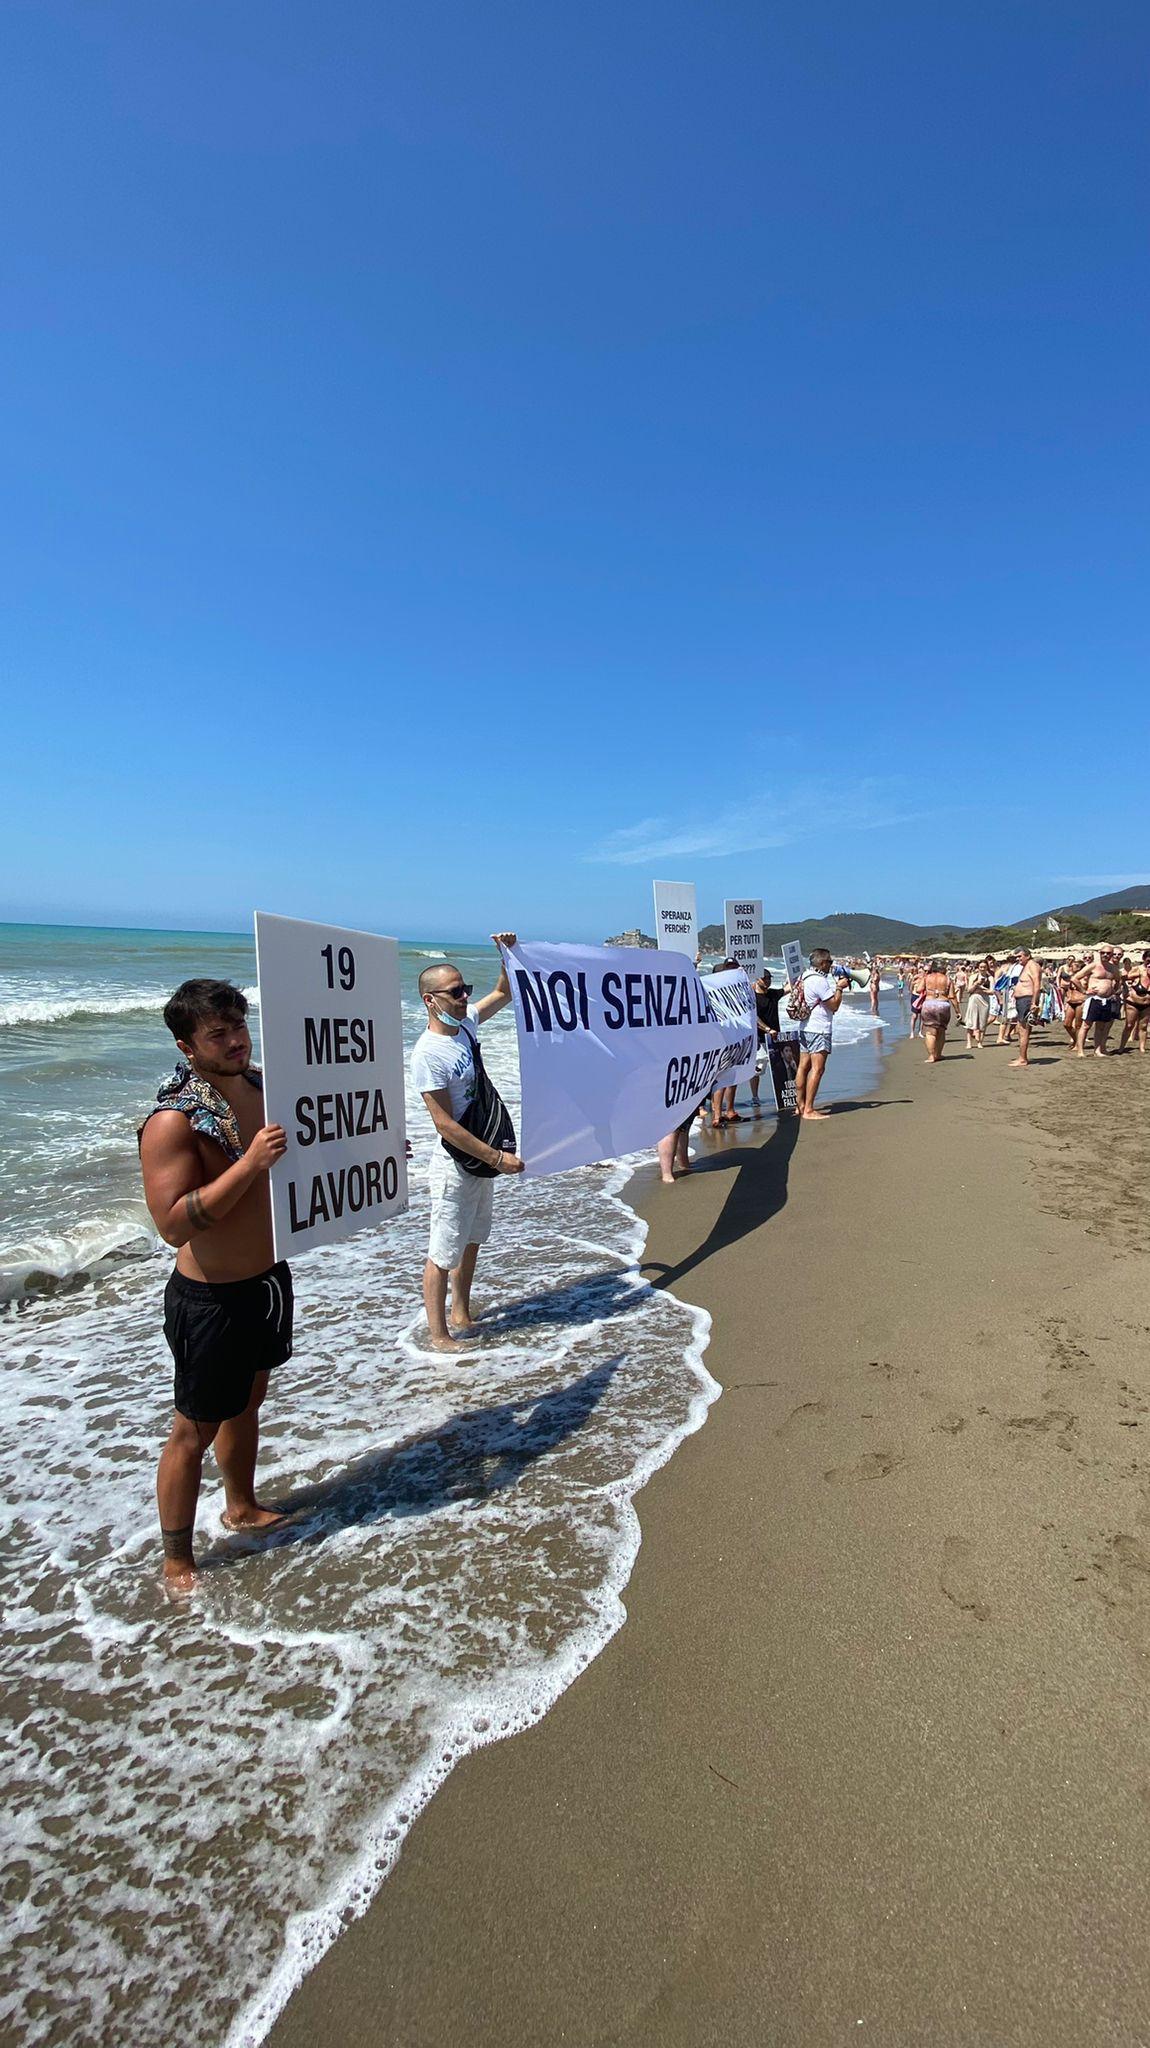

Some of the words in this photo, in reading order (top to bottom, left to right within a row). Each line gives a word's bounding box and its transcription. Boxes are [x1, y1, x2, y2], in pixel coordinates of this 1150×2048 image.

[661, 910, 692, 921] SPERANZA
[734, 904, 755, 915] GREEN
[737, 919, 753, 930] PASS
[730, 935, 743, 946] PER
[744, 934, 760, 944] TUTTI
[734, 950, 746, 960] PER
[747, 949, 757, 959] NOI
[320, 944, 355, 991] 19
[515, 969, 590, 1033] NOI
[601, 971, 692, 1030] SENZA
[304, 1018, 375, 1065] MESI
[664, 1048, 721, 1108] GRAZIE
[295, 1089, 388, 1147] SENZA
[288, 1156, 398, 1234] LAVORO
